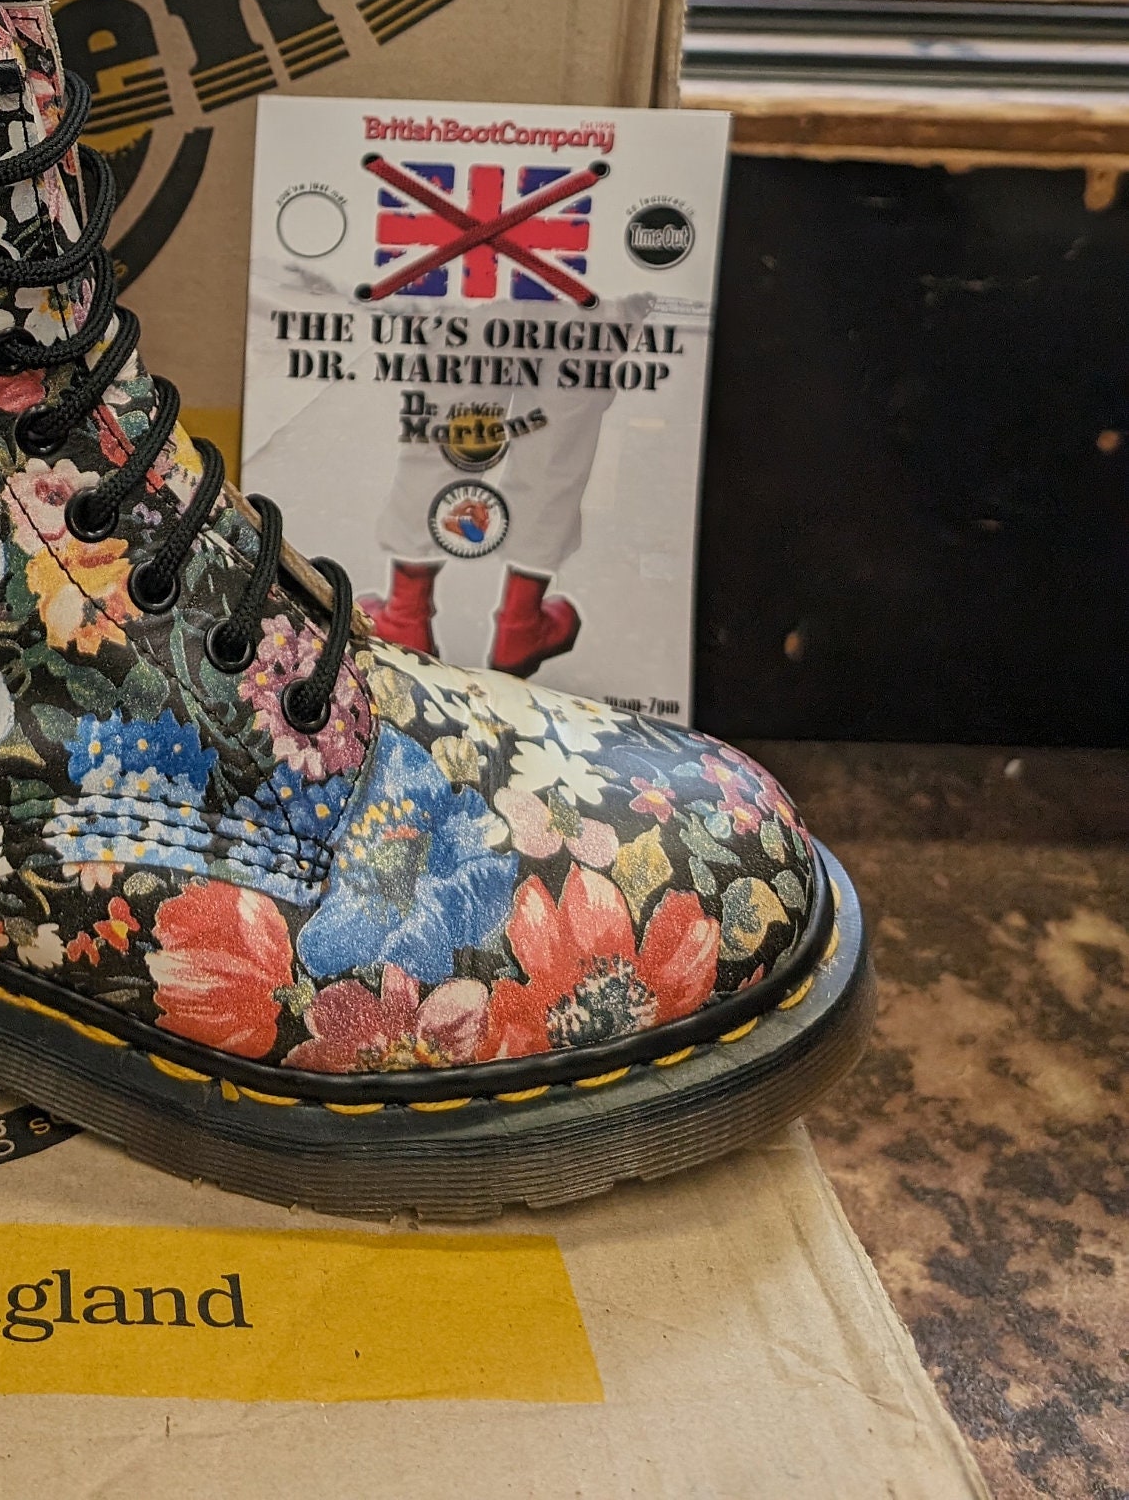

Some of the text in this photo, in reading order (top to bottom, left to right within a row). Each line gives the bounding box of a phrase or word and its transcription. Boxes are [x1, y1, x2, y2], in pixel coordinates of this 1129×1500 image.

[363, 115, 615, 153] BritishBootCompany
[271, 309, 684, 356] THE UK'S ORIGINAL
[287, 348, 671, 391] DR. MARTEN SHOP
[398, 406, 548, 444] Martens
